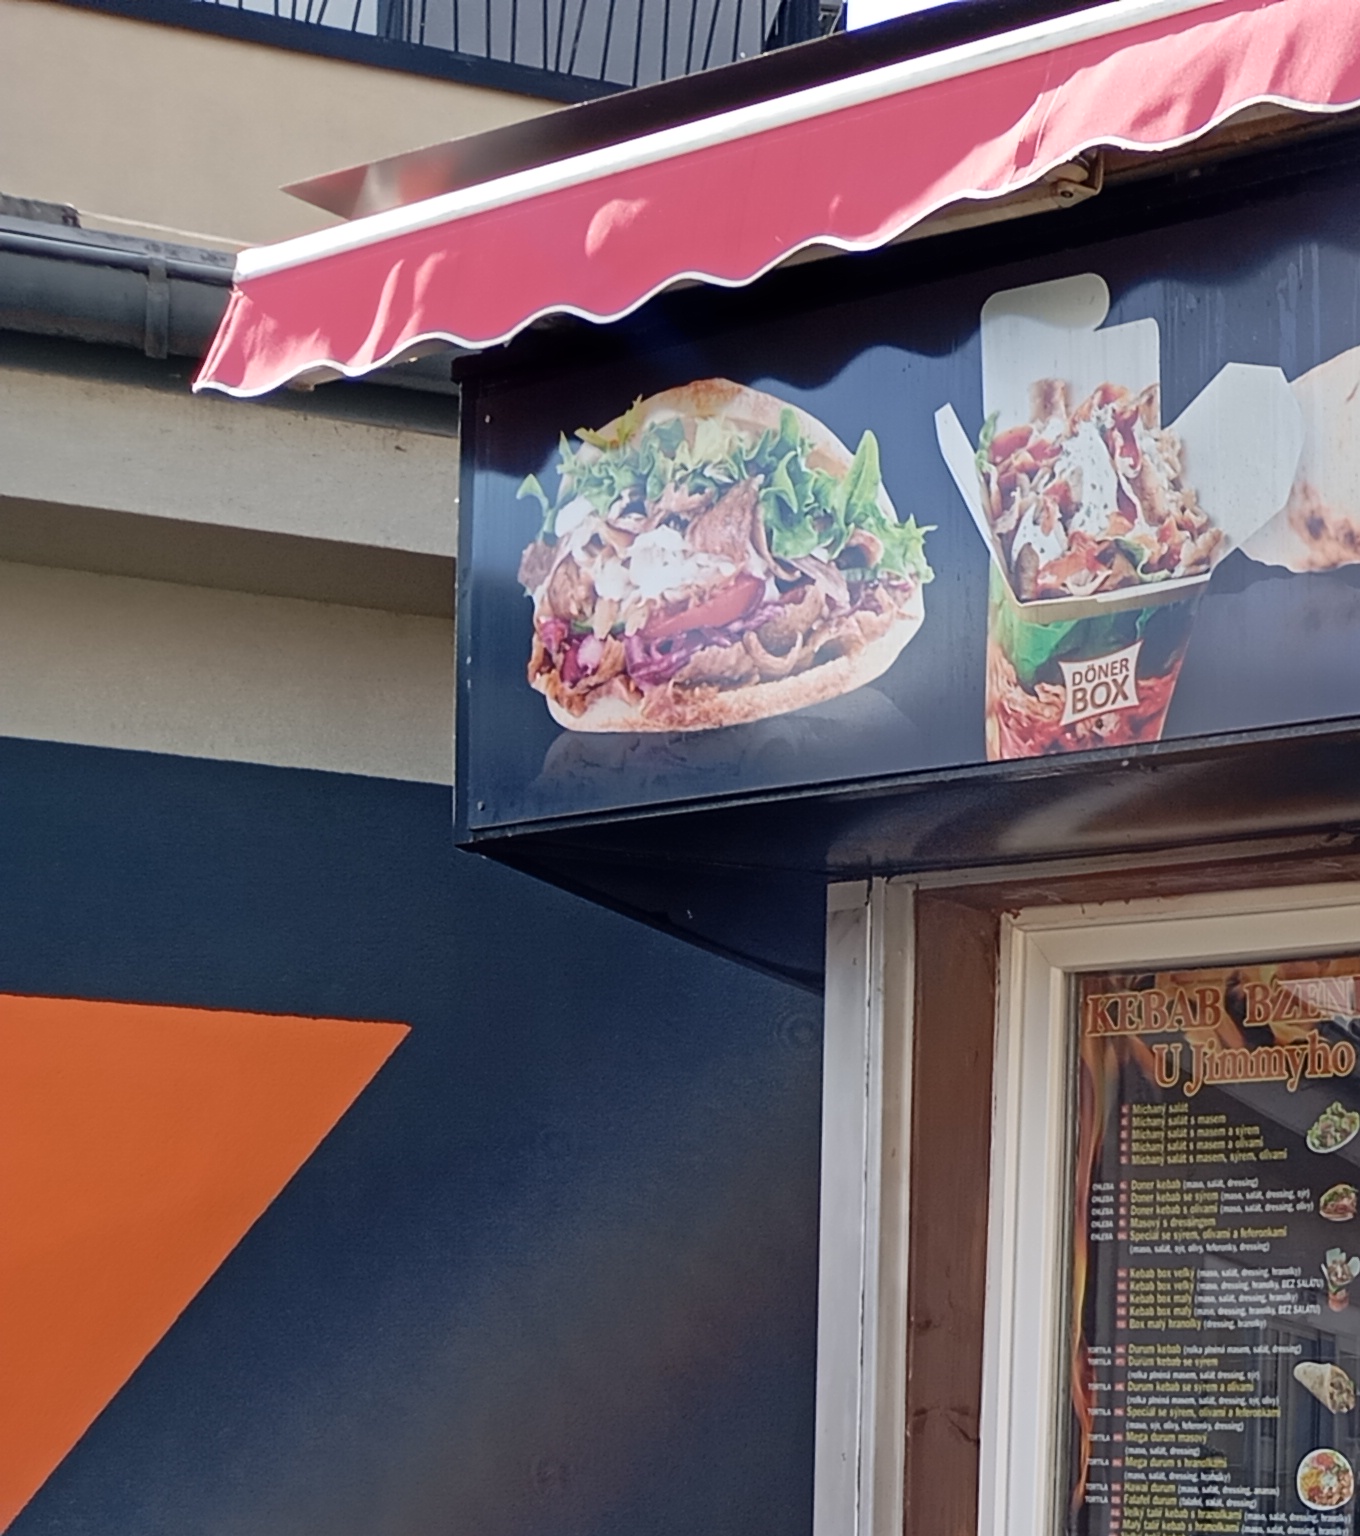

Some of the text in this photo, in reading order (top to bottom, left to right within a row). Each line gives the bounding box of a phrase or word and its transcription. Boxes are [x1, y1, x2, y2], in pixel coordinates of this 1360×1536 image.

[1072, 658, 1129, 687] DÖNER
[1072, 674, 1129, 715] BOX
[1086, 986, 1222, 1037] KEBAB
[1152, 1029, 1356, 1097] U Jimmyho
